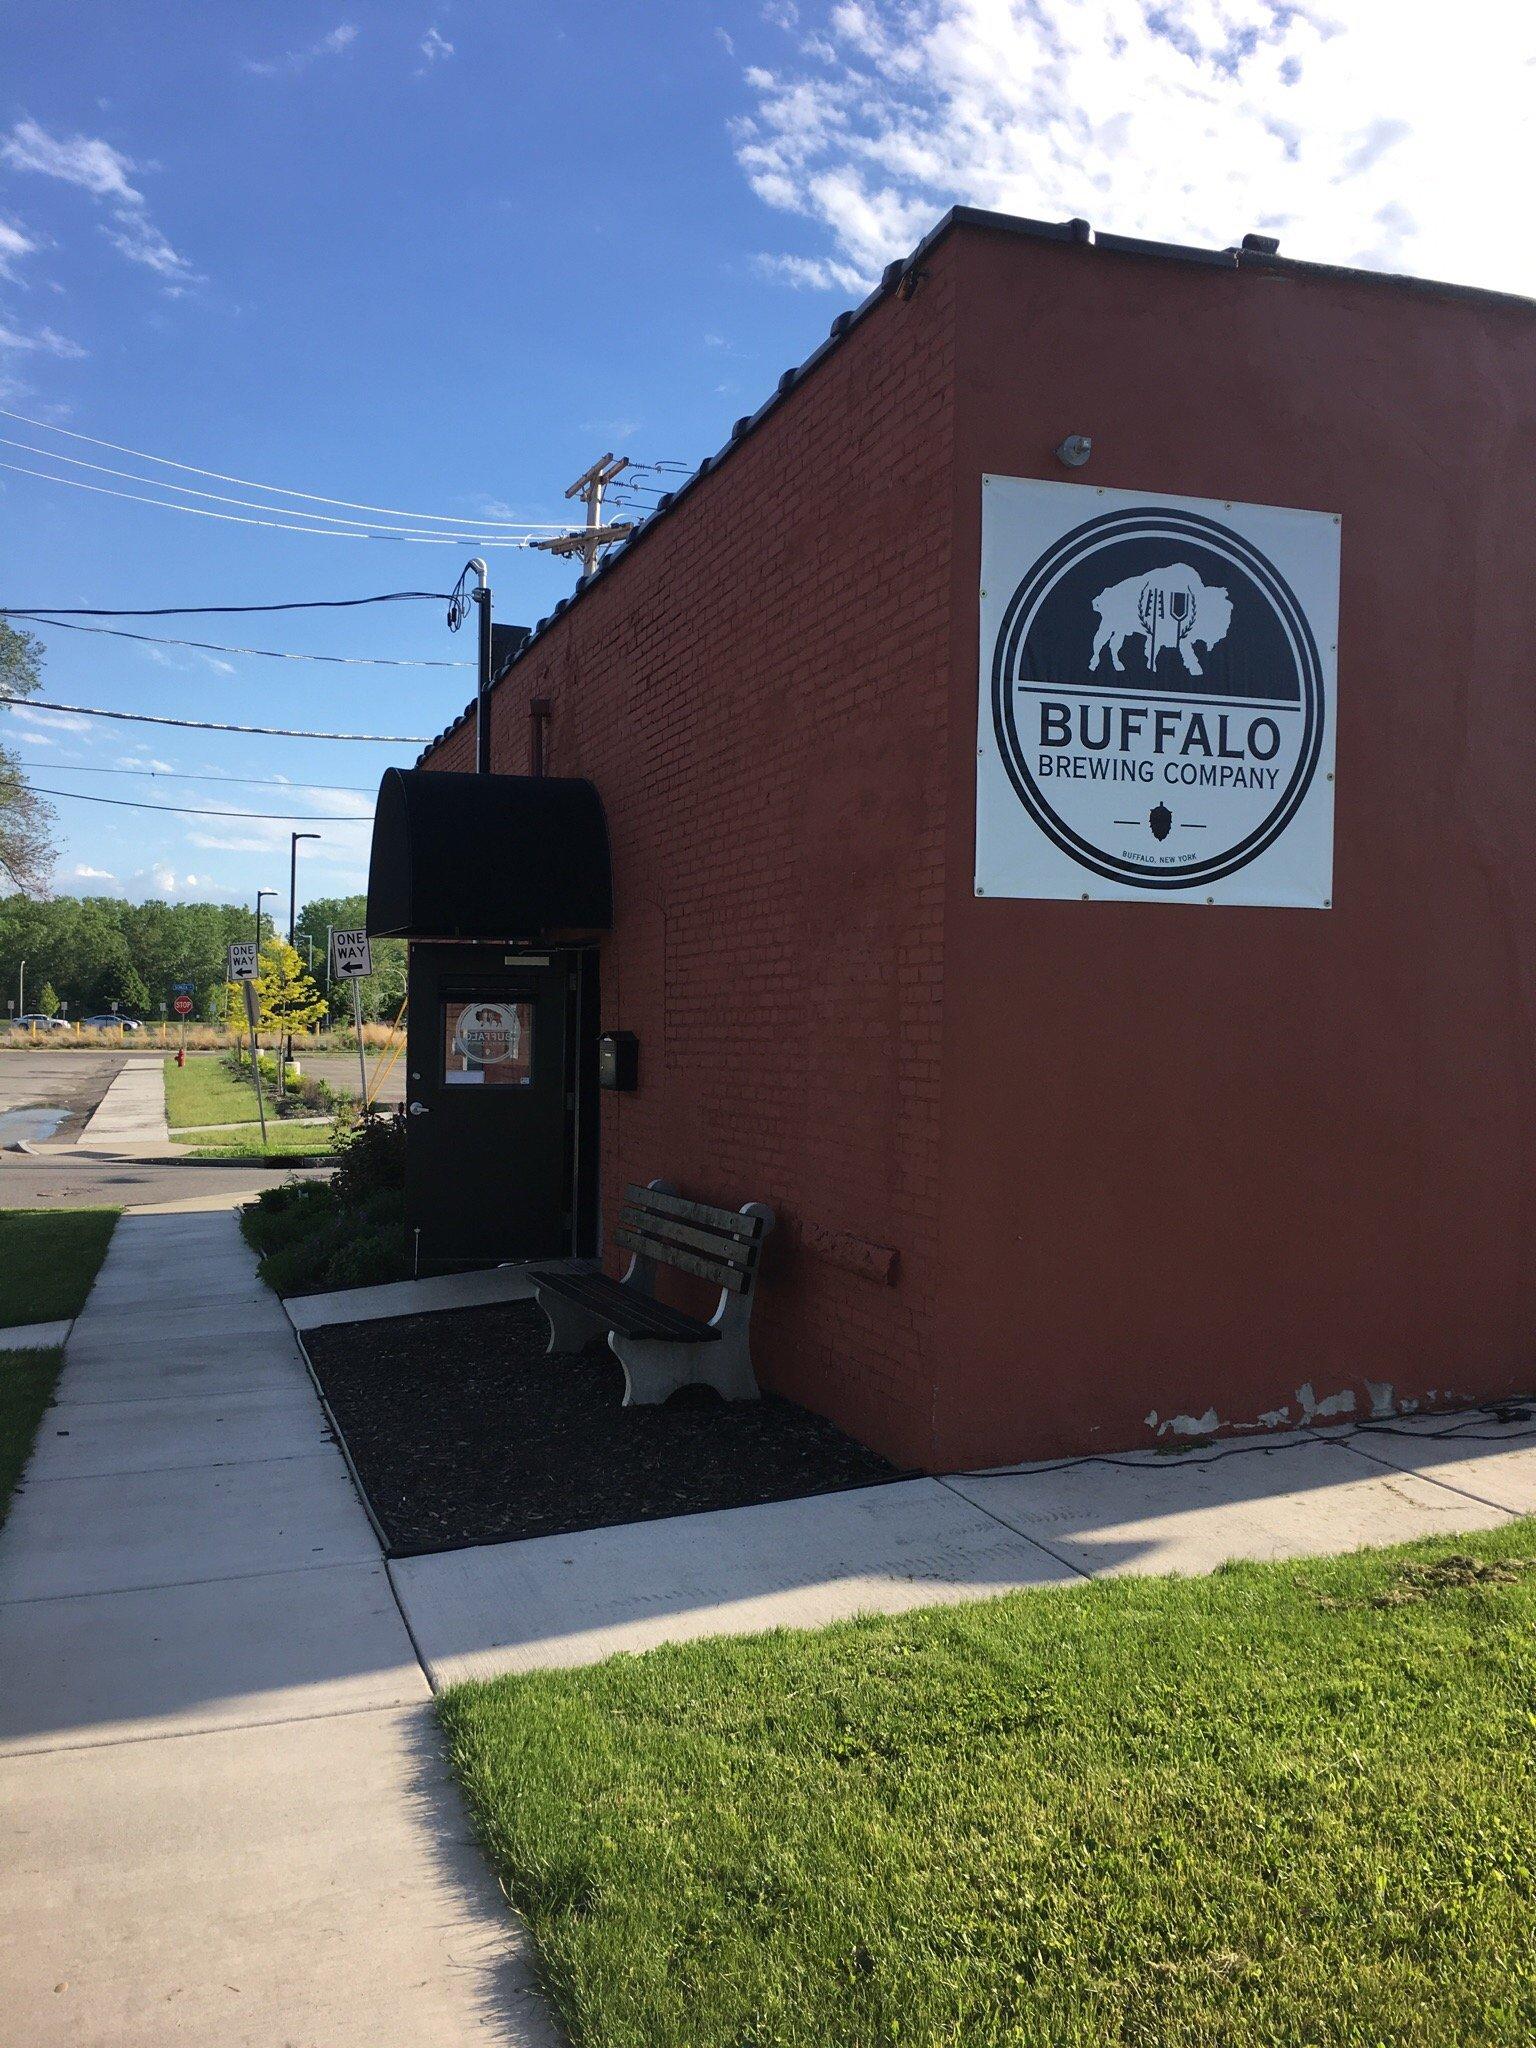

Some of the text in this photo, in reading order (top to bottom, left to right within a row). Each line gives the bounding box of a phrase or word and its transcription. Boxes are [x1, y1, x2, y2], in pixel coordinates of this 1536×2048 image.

[1039, 701, 1281, 761] BUFFALO
[1038, 754, 1280, 790] BREWING COMPANY
[1122, 850, 1197, 864] BUFFALO, NEW YORK
[337, 932, 365, 945] ONE
[233, 946, 254, 956] ONE
[338, 946, 366, 959] WAY
[233, 957, 255, 966] WAY
